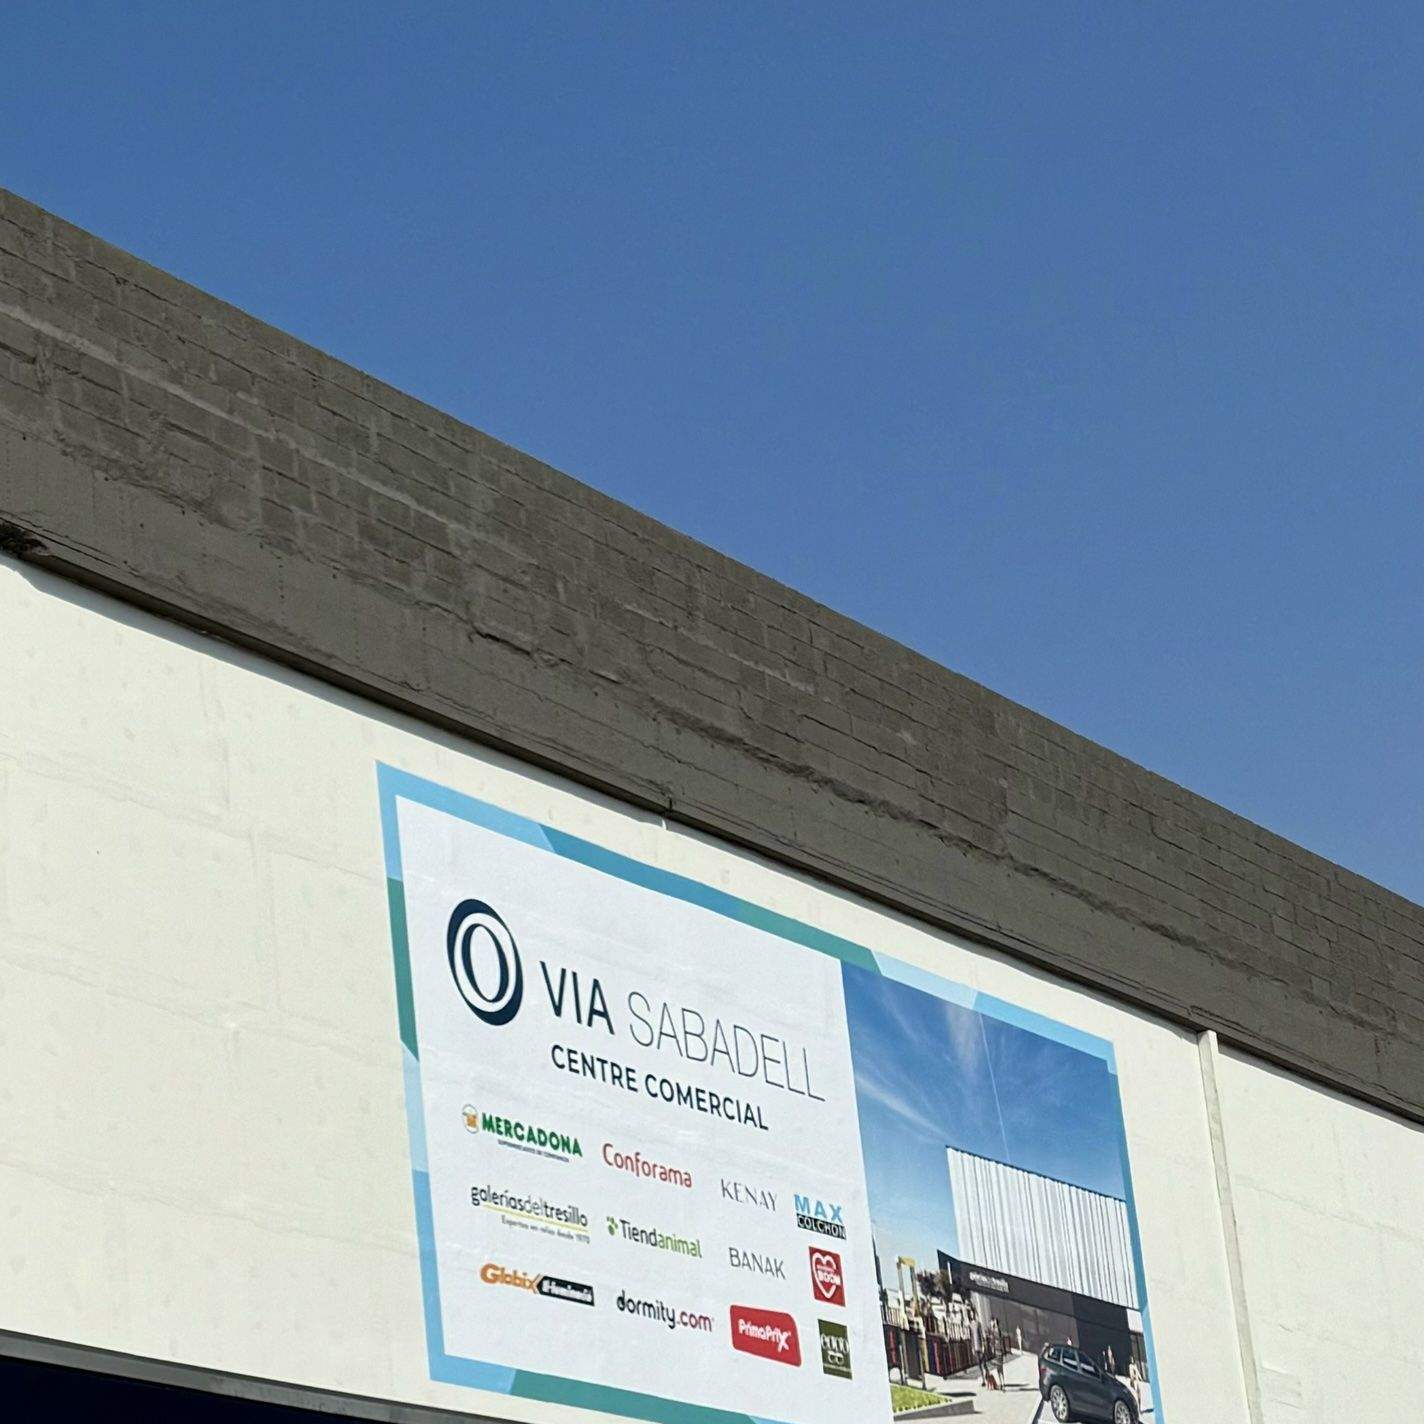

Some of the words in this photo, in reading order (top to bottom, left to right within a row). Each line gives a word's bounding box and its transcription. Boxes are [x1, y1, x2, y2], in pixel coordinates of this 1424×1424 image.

[539, 961, 615, 1035] VIA
[627, 991, 826, 1102] SABADELL
[551, 1044, 638, 1093] CENTRE
[644, 1073, 769, 1131] COMERCIAL
[482, 1112, 583, 1157] MERCADONA
[603, 1143, 692, 1188] Conforama
[721, 1178, 778, 1212] KENAY
[794, 1194, 843, 1222] MAX
[620, 1219, 702, 1258] Tiendanimal
[797, 1215, 847, 1239] COLCHON
[729, 1247, 786, 1280] BANAK
[616, 1289, 712, 1332] dormity.com
